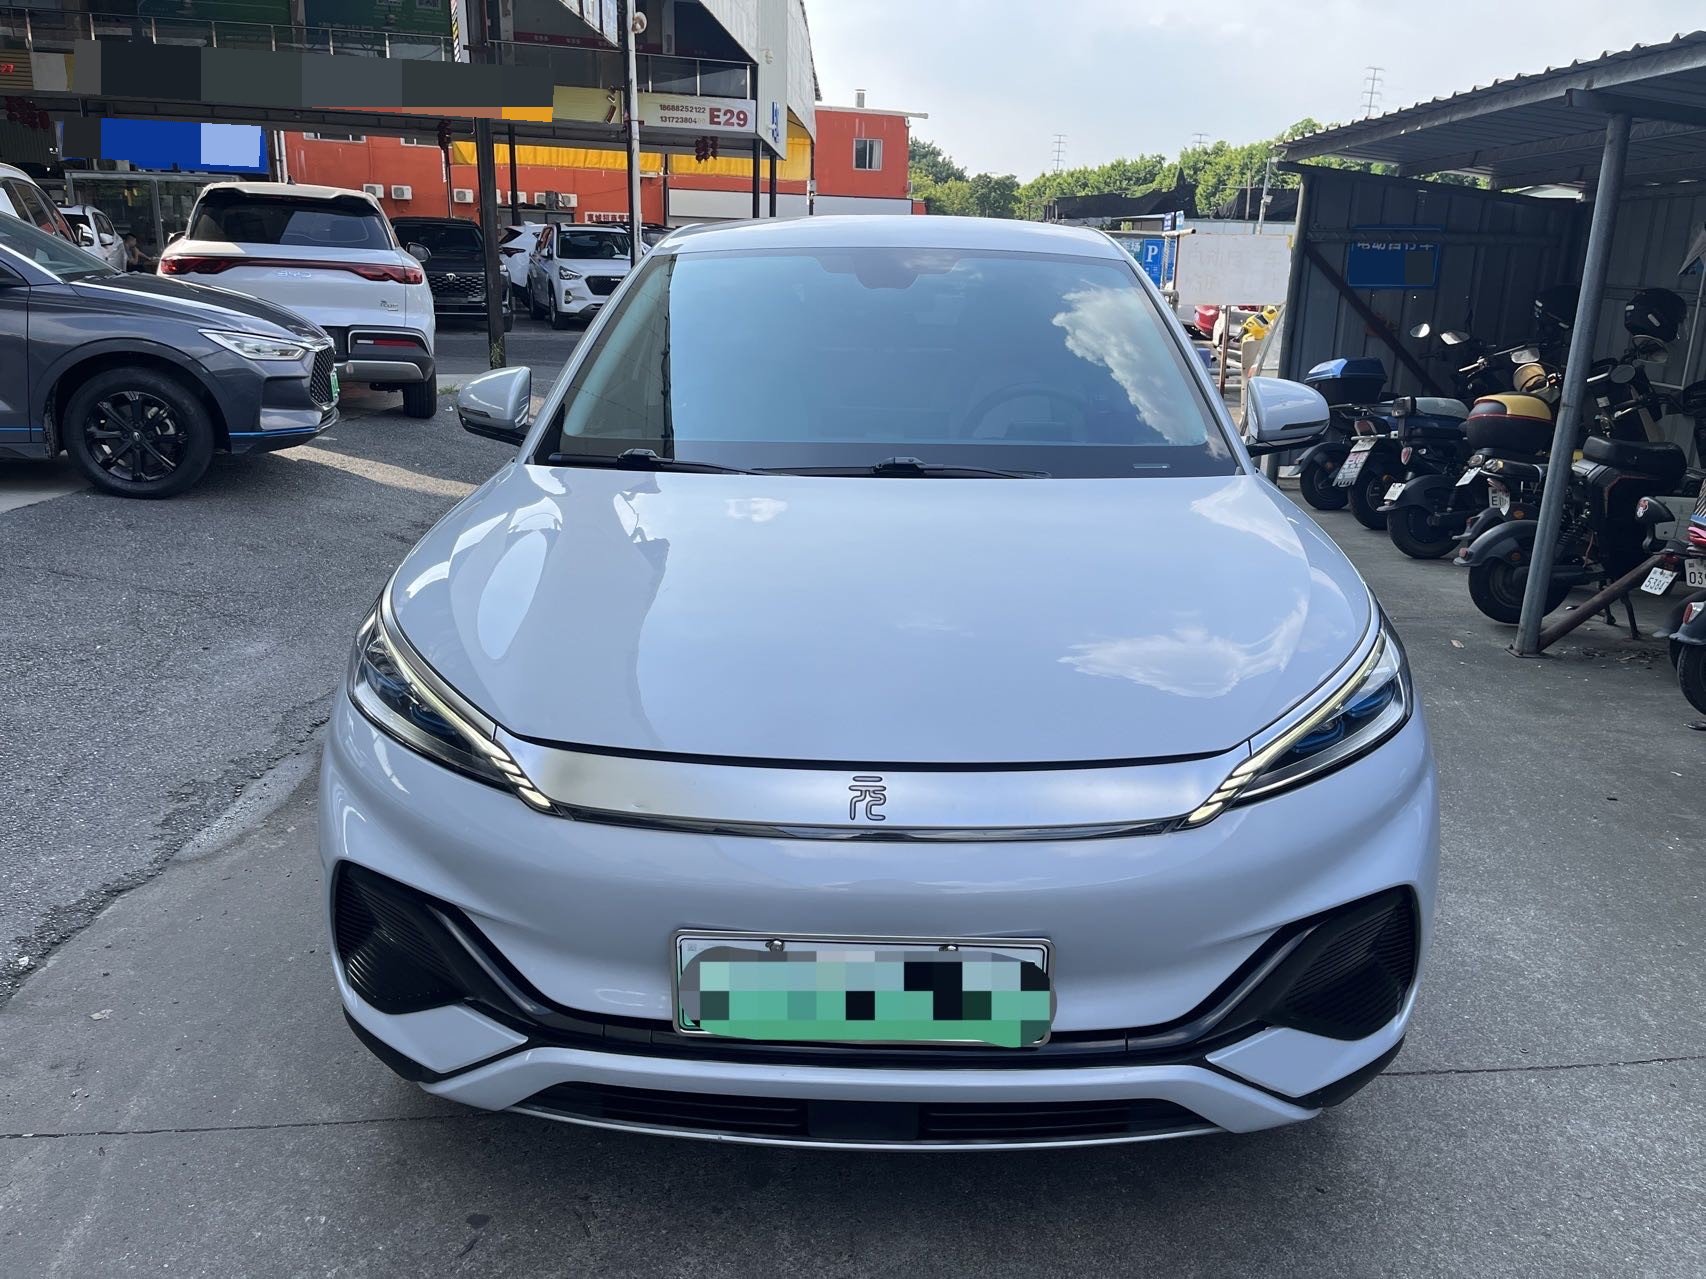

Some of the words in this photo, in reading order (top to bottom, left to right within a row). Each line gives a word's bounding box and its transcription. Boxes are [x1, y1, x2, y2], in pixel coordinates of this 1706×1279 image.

[659, 104, 706, 114] 18688252122
[659, 115, 706, 125] 131723804
[708, 107, 748, 128] E29
[1145, 244, 1159, 263] P
[1689, 571, 1706, 586] 03
